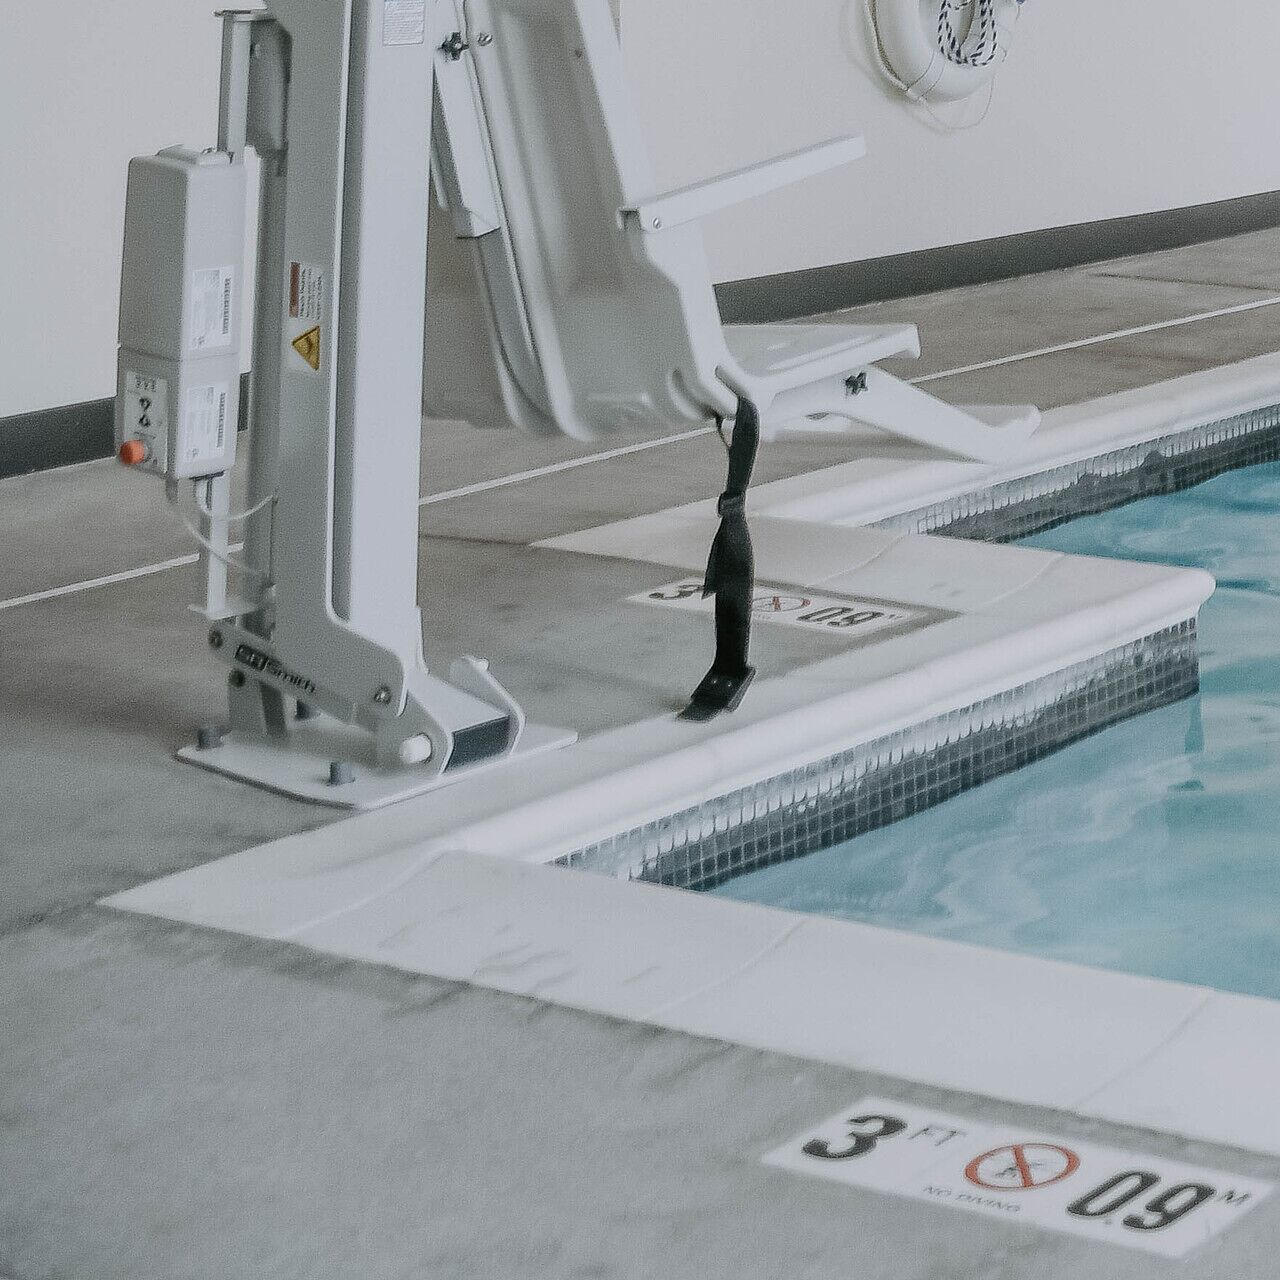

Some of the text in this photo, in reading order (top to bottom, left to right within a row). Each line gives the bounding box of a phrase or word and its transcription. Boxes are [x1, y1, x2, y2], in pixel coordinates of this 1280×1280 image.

[802, 1114, 908, 1159] 3
[908, 1123, 969, 1148] FT
[922, 1185, 1021, 1213] NO DIVING
